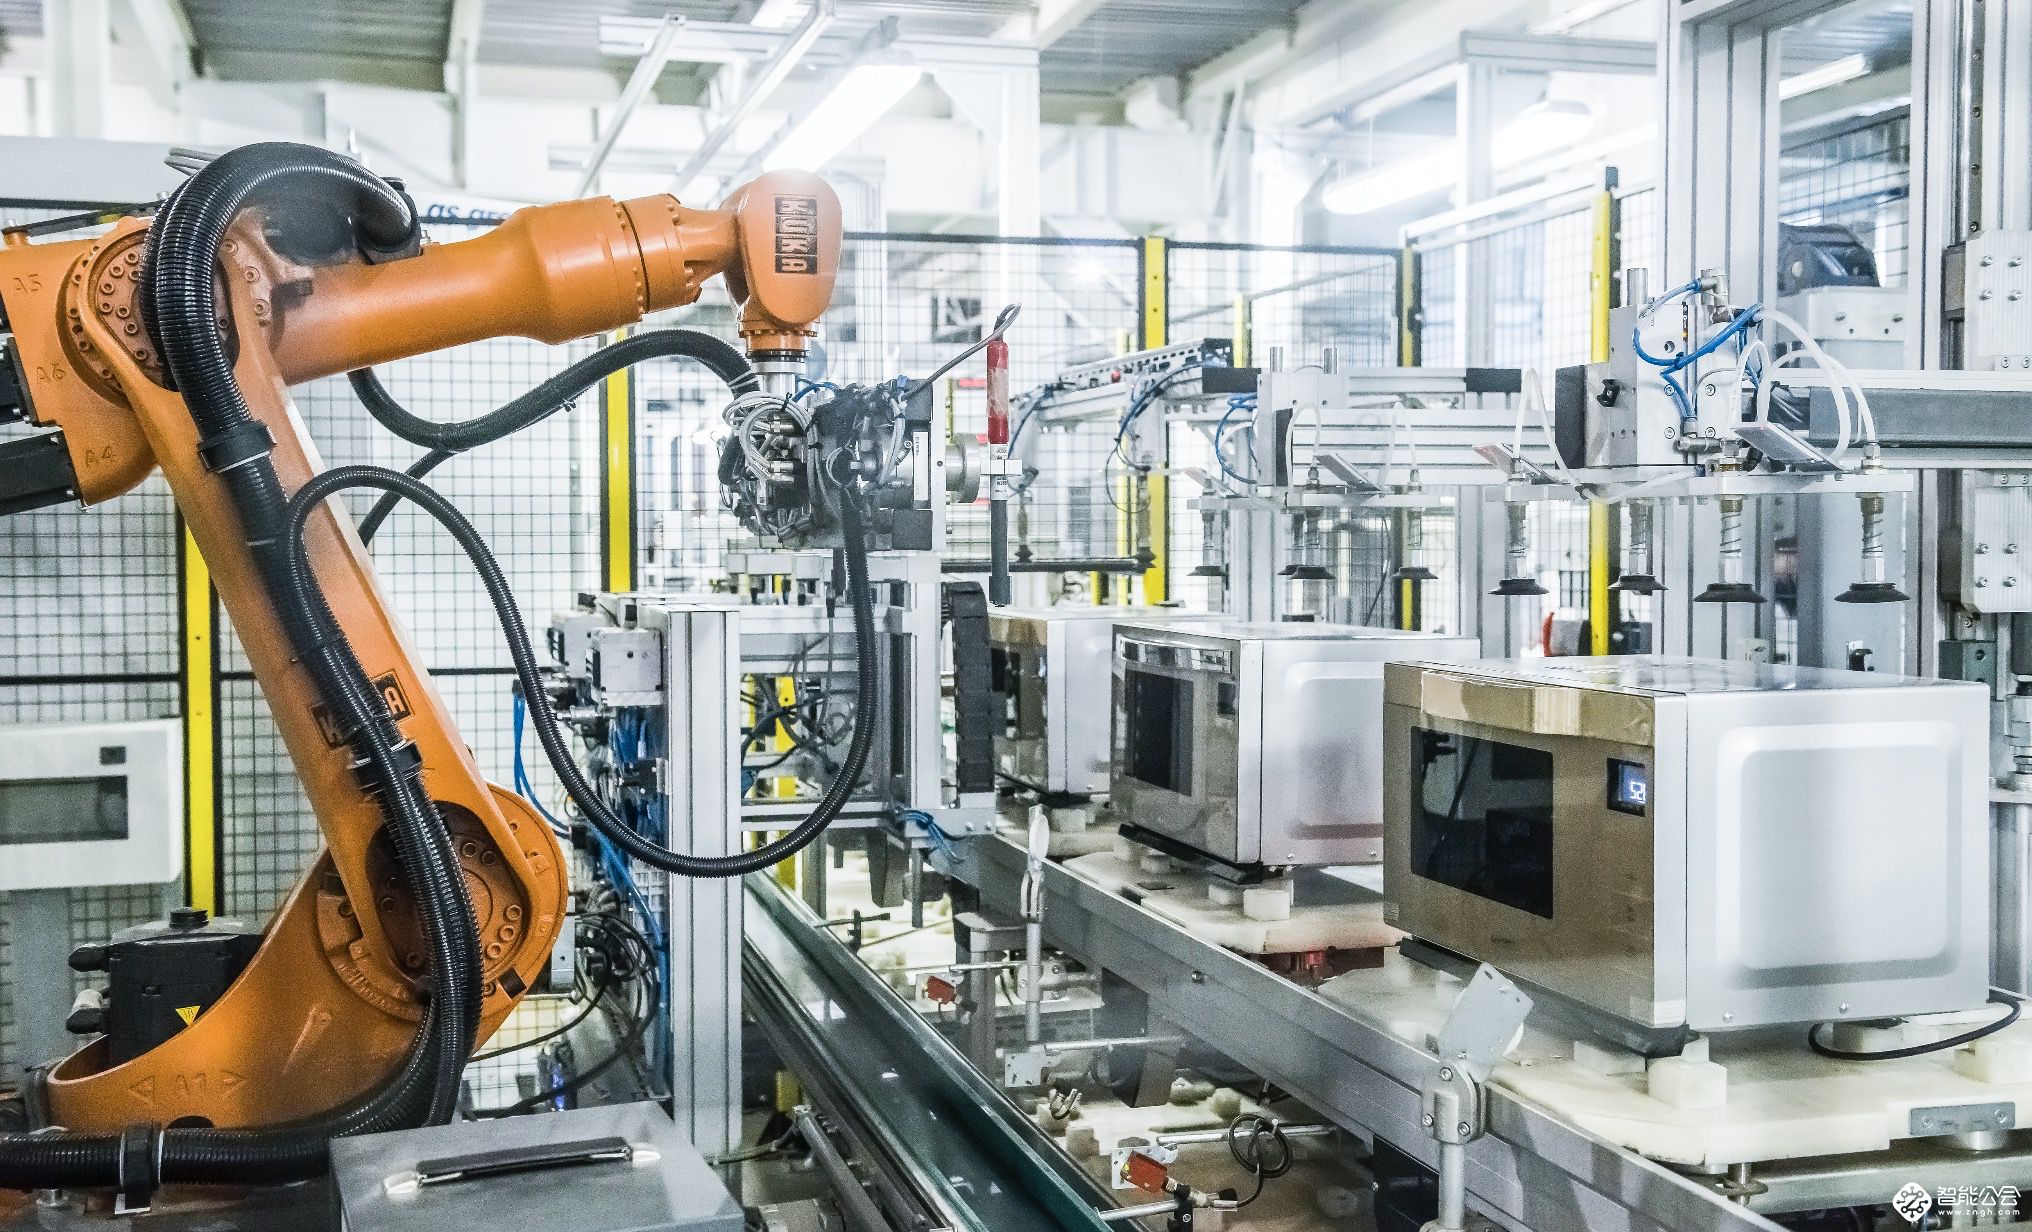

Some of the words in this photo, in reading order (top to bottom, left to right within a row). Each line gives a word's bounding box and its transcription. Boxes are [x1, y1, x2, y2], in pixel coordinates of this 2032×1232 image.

[778, 197, 813, 273] KUKA
[36, 362, 66, 384] A6
[85, 445, 117, 467] A4
